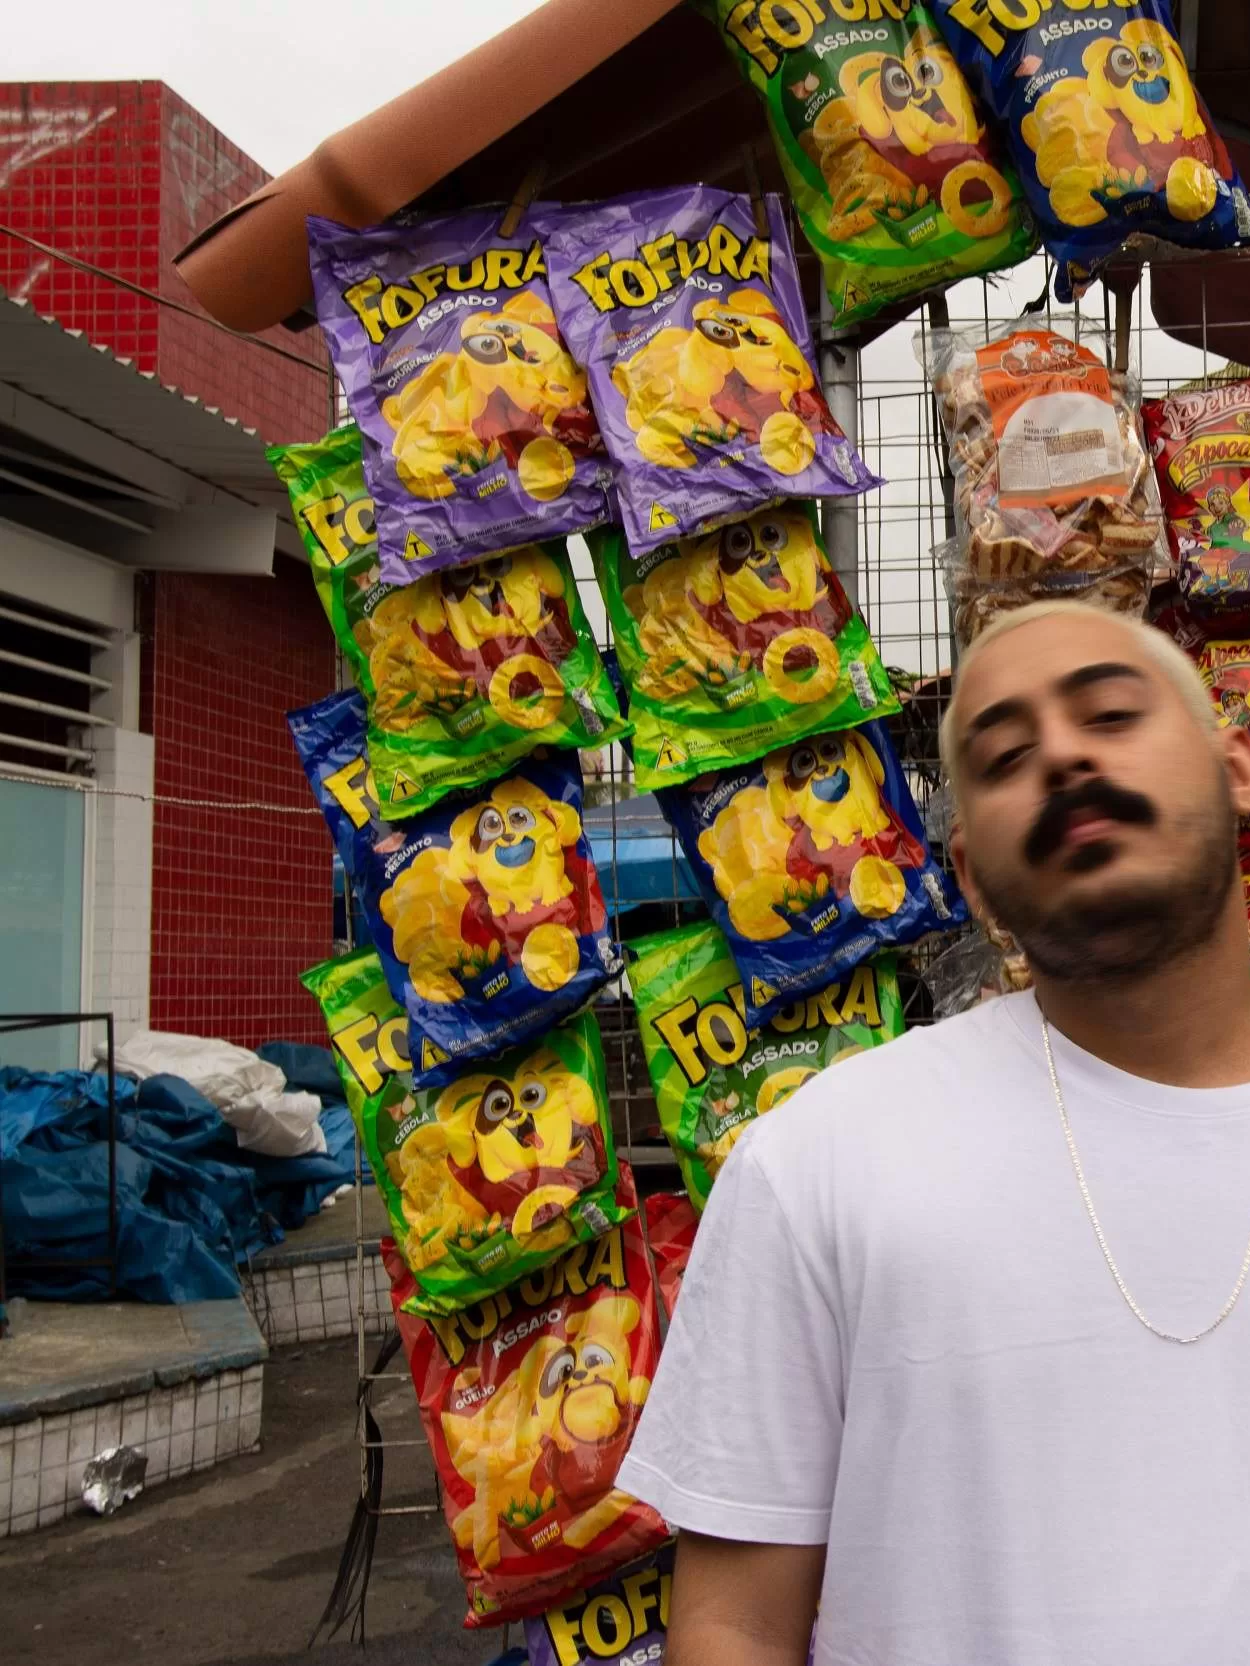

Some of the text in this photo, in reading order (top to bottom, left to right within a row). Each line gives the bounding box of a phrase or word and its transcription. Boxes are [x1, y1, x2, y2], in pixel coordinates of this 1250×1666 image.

[814, 29, 888, 60] ASSADO
[1039, 18, 1112, 46] ASSADO
[1024, 67, 1068, 103] PRESUNTO
[804, 88, 836, 122] CEBOLA
[568, 223, 775, 313] FOFURA
[343, 240, 547, 344] FOFURA
[651, 276, 723, 315] ASADO
[416, 295, 497, 331] ASSADO
[656, 512, 666, 525] T
[409, 542, 420, 555] T
[663, 750, 674, 763] T
[397, 781, 407, 794] T
[702, 774, 748, 820] PRESUNTO
[384, 835, 433, 881] PRESUNTO
[812, 907, 839, 935] MILHO
[740, 1039, 819, 1079] ASSADO
[394, 1110, 430, 1145] CEBOLA
[714, 1108, 752, 1137] CEBOLA
[492, 1307, 563, 1359] ASSADO
[455, 1384, 496, 1411] QUEIJO
